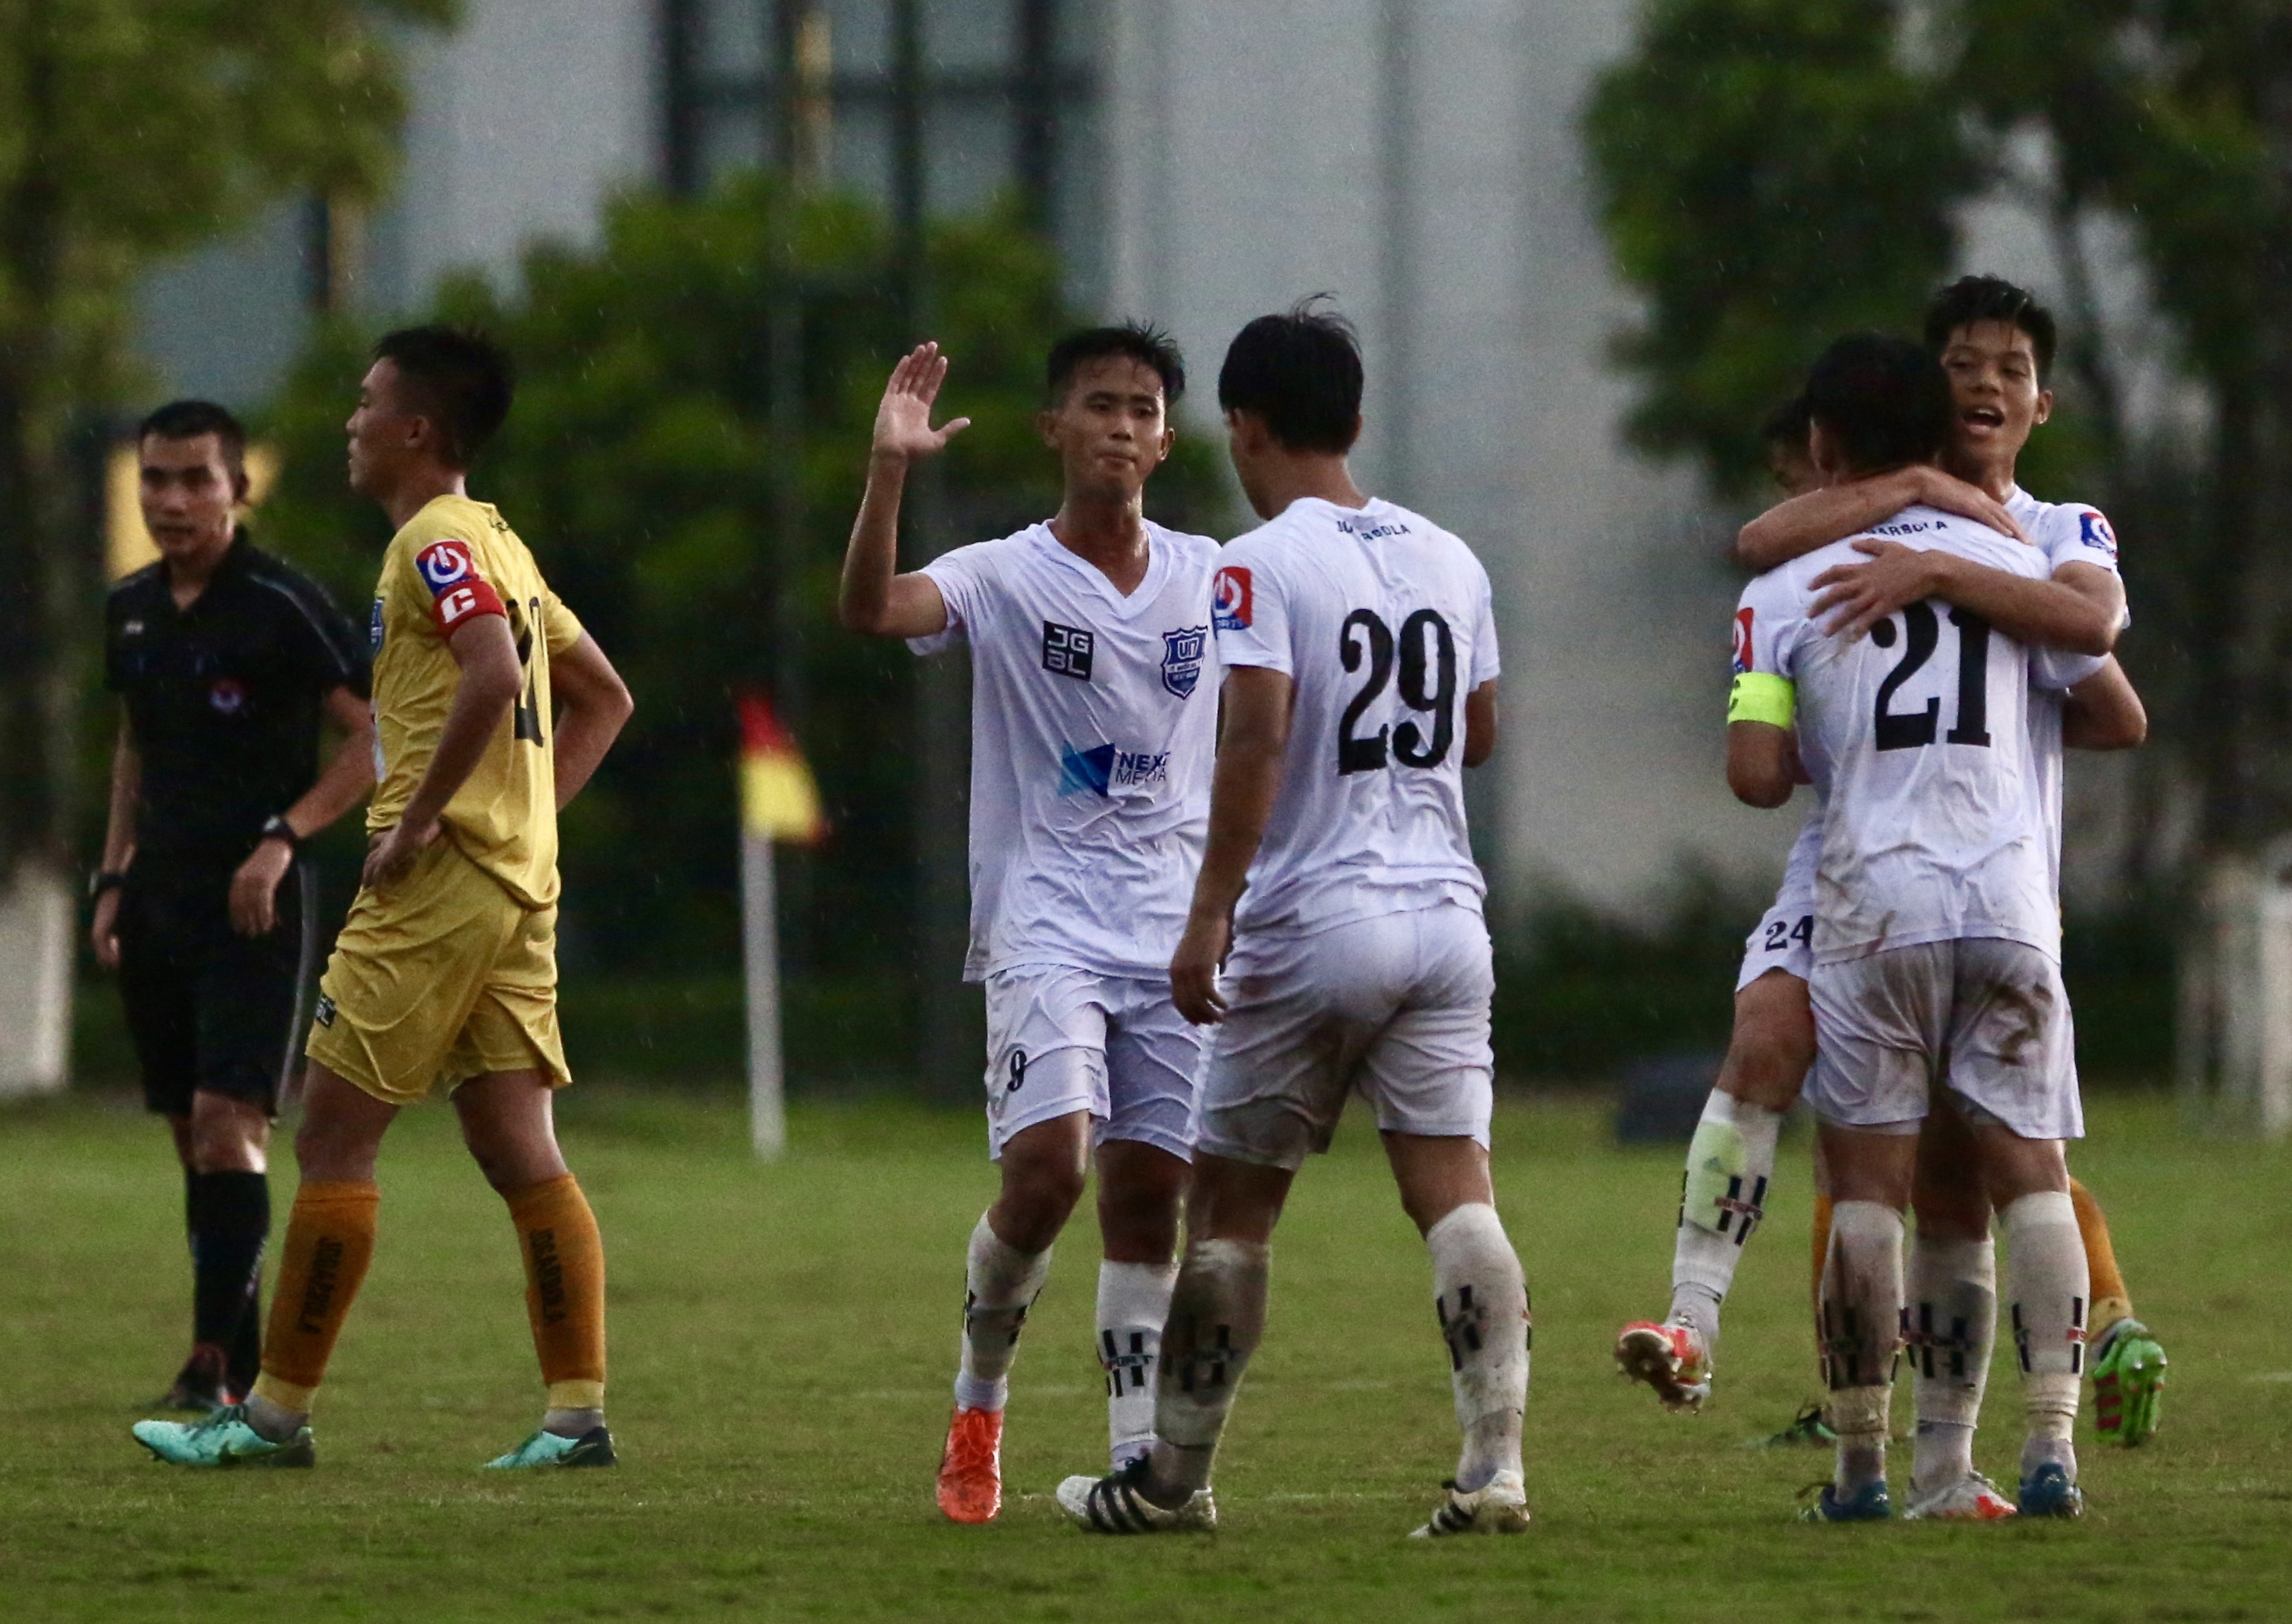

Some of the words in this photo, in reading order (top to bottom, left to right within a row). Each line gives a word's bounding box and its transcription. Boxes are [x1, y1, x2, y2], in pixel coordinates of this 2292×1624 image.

[440, 589, 476, 624] C
[1337, 608, 1457, 776] 29
[1870, 599, 1991, 752] 21
[1764, 914, 1814, 952] 24
[1007, 1050, 1028, 1092] 9
